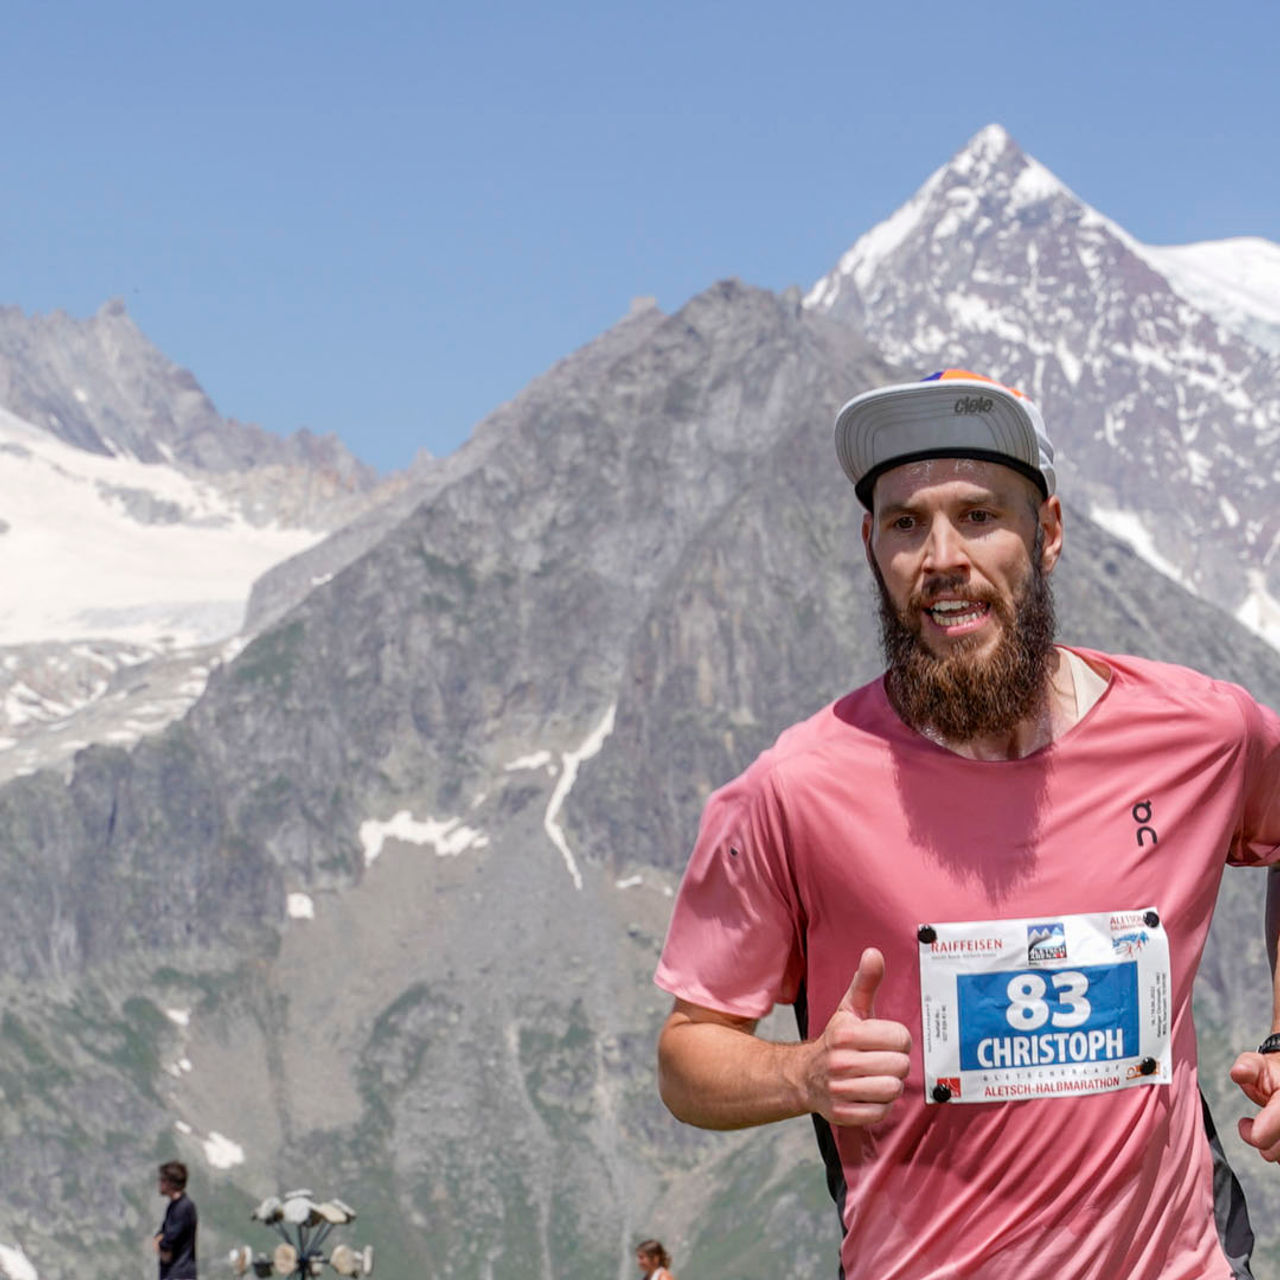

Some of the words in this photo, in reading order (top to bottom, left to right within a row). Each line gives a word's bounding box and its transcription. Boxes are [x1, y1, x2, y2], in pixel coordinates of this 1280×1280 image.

[931, 938, 1003, 953] RAIFFEISEN
[1006, 971, 1091, 1031] 83
[977, 1028, 1123, 1068] CHRISTOPH
[984, 1076, 1120, 1097] ALETSCH-HALBMARATHON
